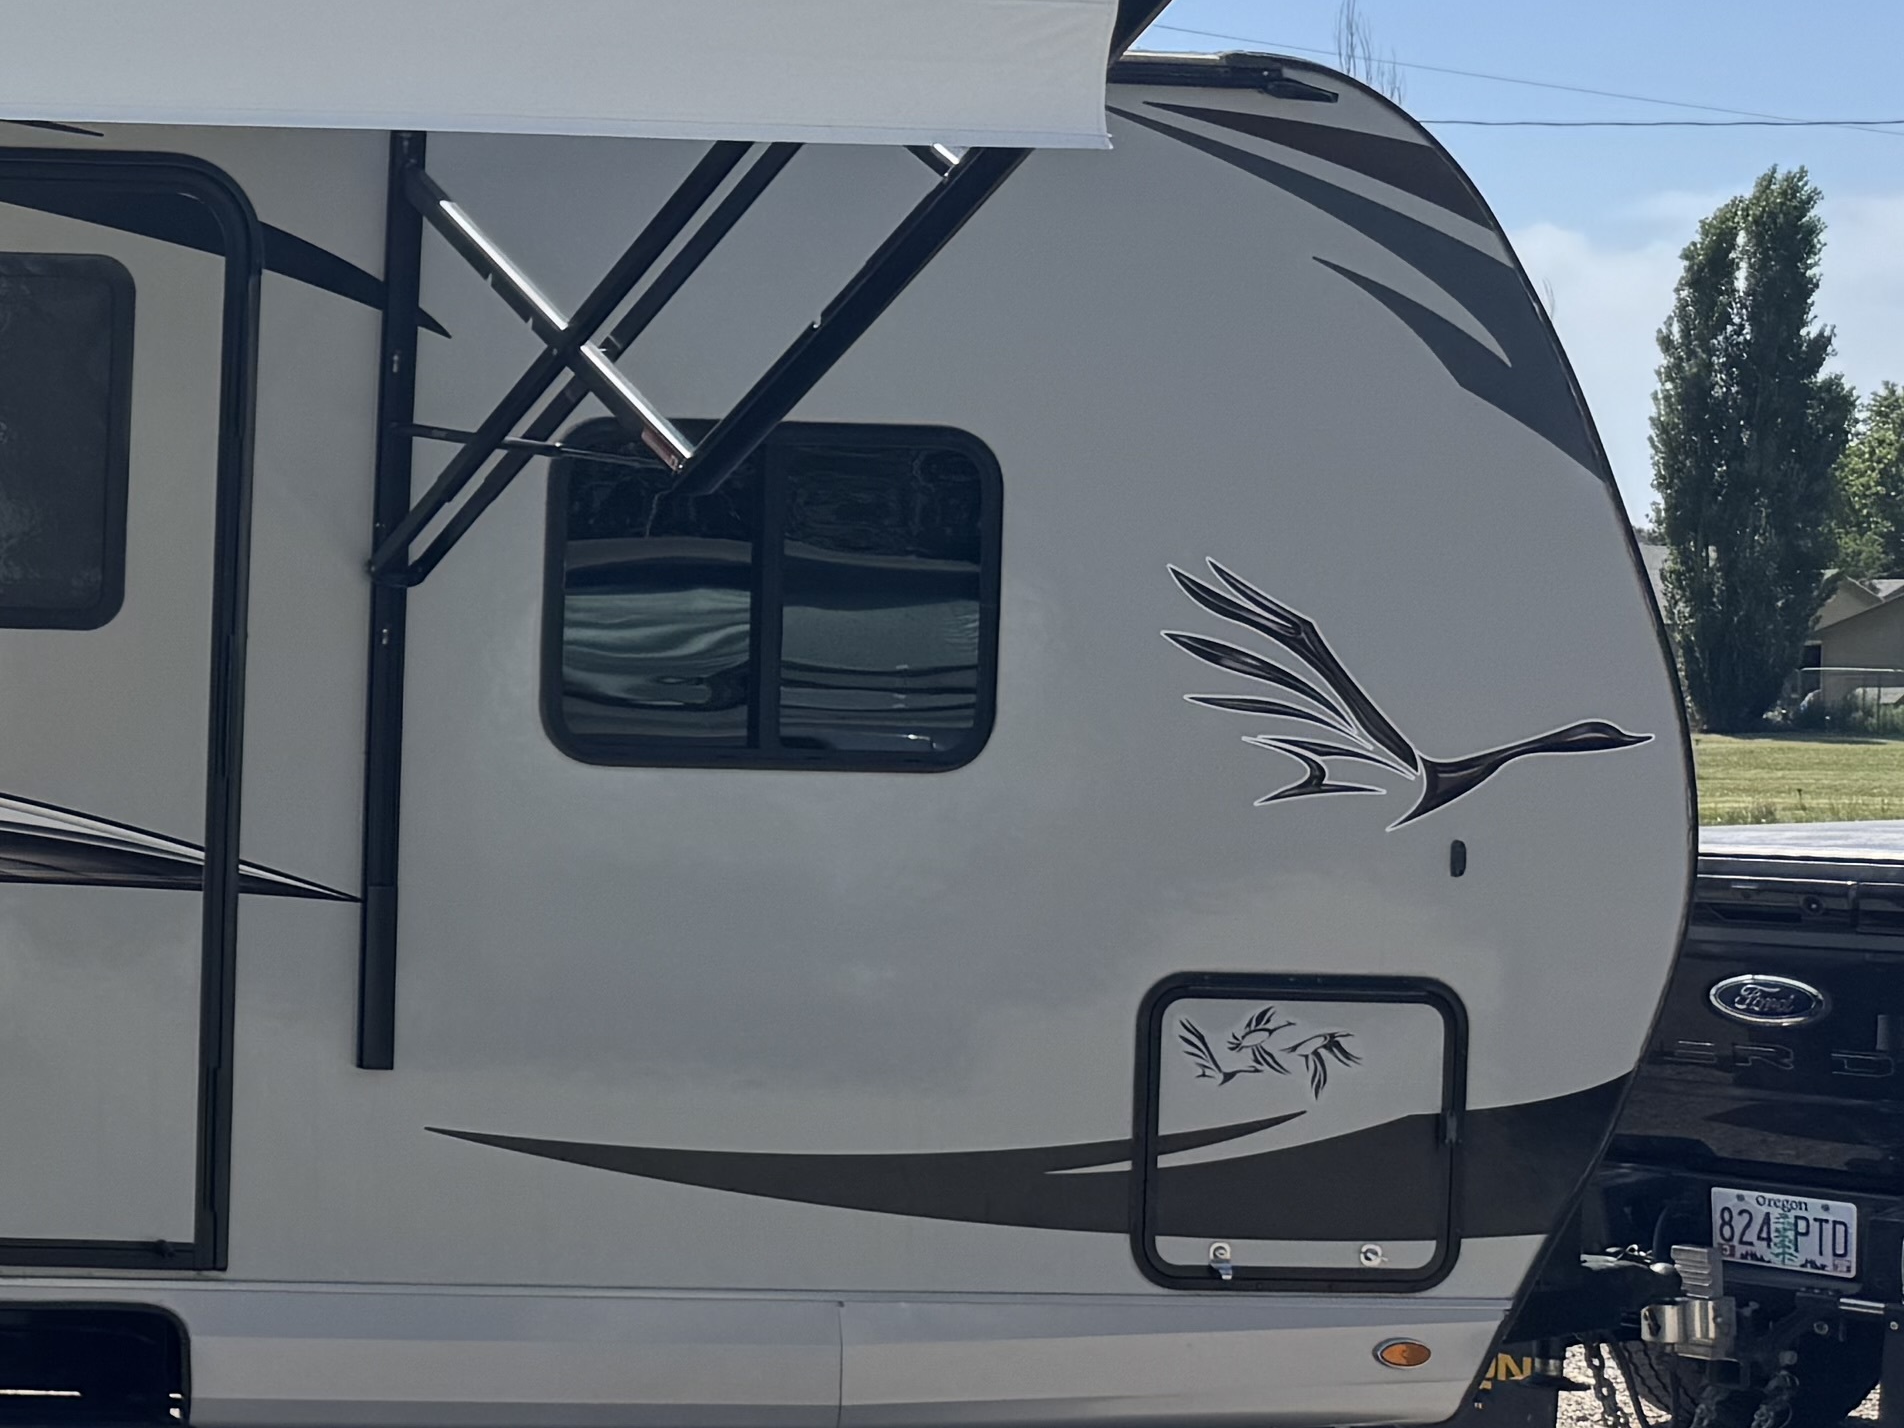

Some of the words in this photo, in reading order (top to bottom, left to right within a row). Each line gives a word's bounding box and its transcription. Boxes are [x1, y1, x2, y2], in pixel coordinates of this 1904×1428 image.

[1733, 983, 1796, 1010] Ford
[1755, 1194, 1809, 1213] Oregon
[1718, 1206, 1773, 1249] 824
[1794, 1214, 1849, 1258] PTD
